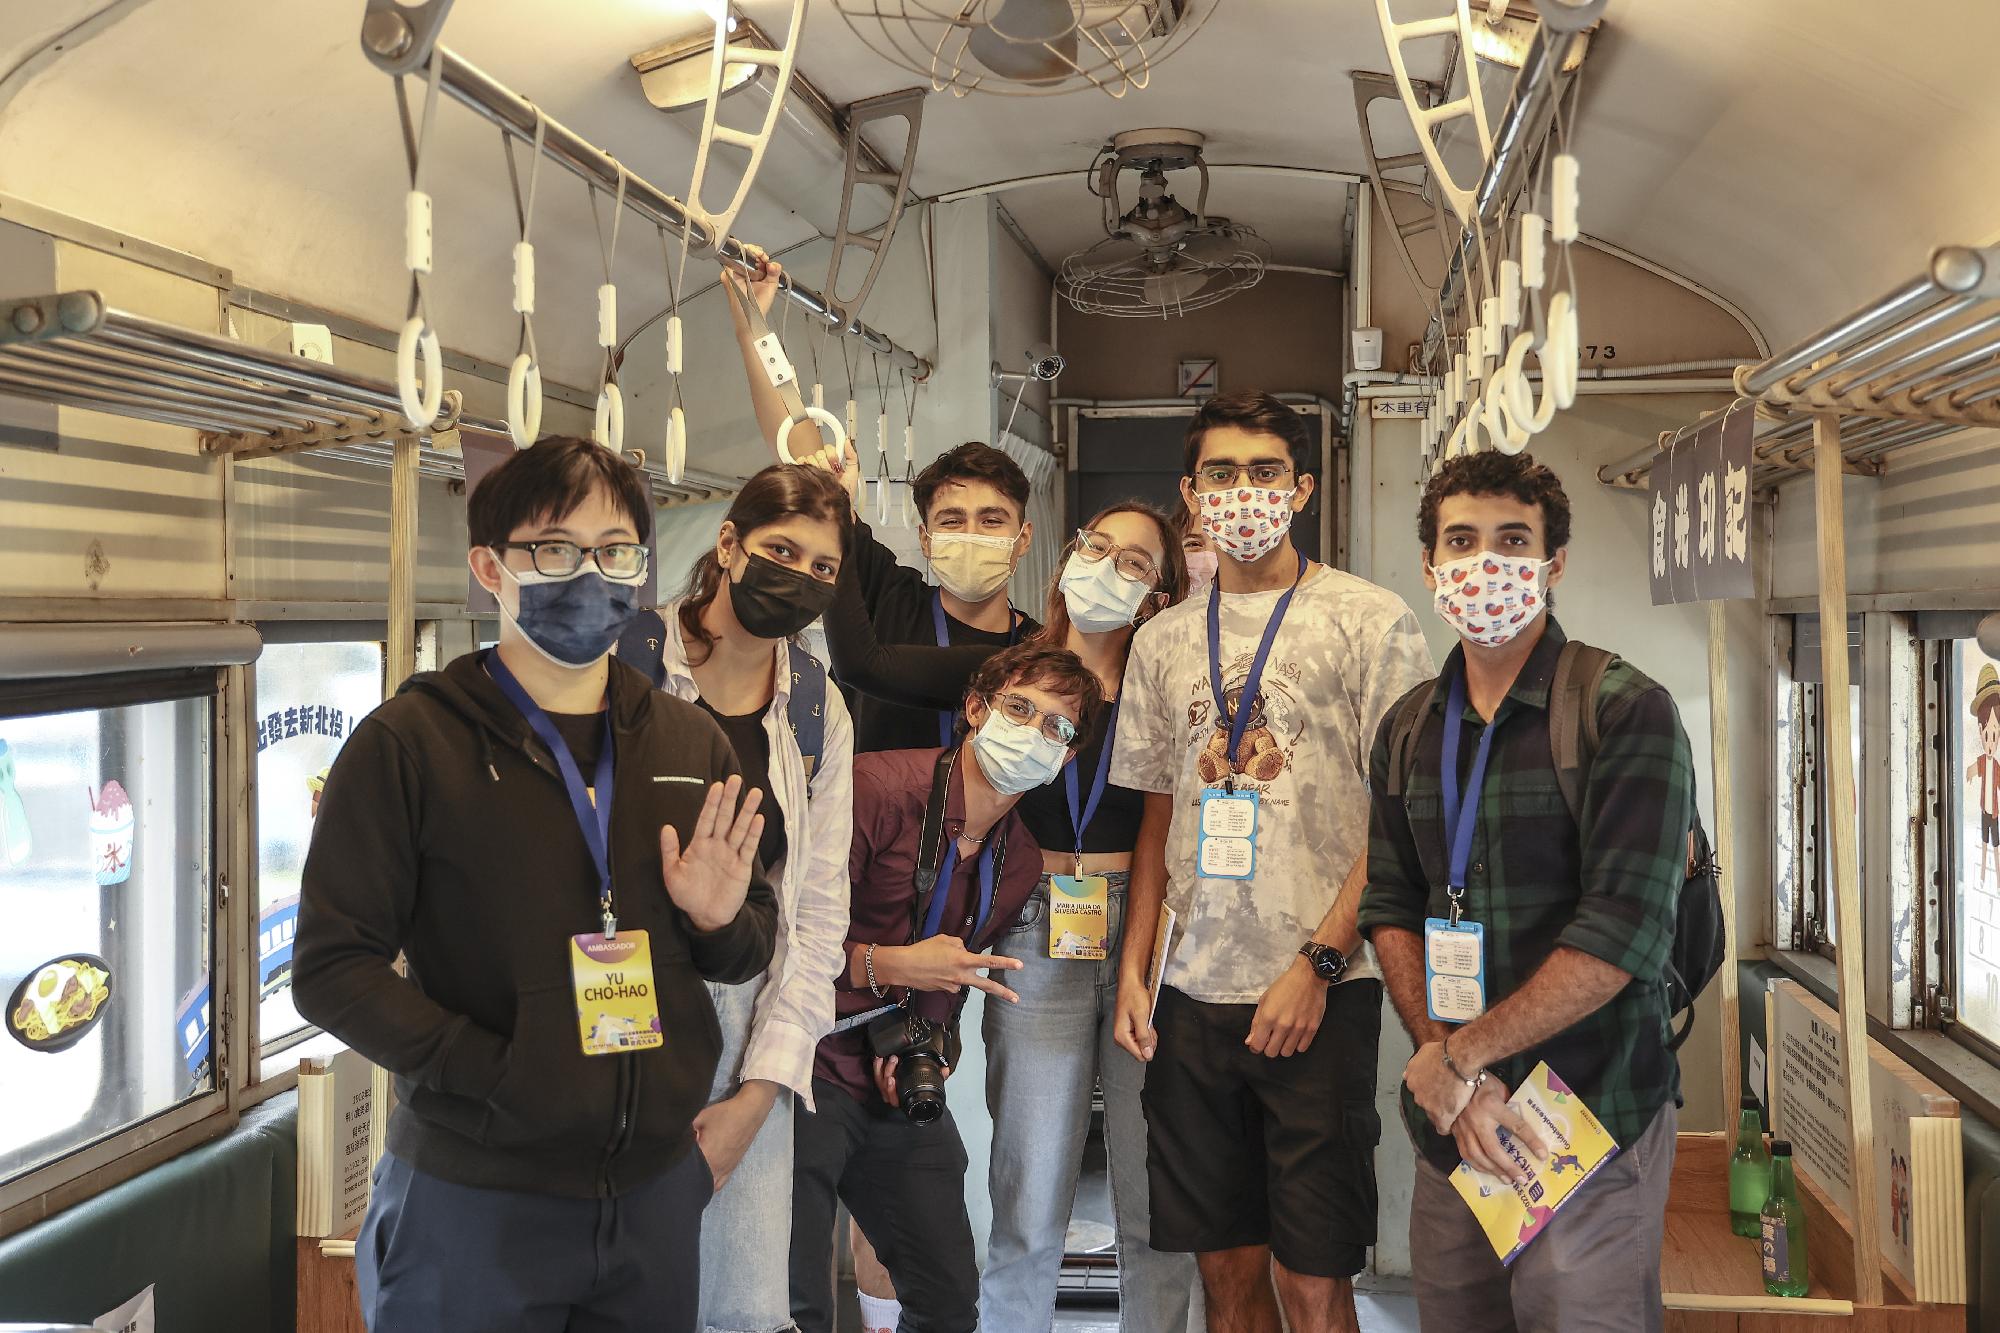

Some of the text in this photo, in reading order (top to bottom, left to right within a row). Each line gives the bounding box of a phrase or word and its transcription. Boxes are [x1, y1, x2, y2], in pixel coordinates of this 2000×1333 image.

[1269, 657, 1302, 684] NASA
[587, 942, 636, 952] AMBASSADOR
[1978, 925, 1985, 954] 8
[605, 973, 624, 985] YU
[584, 984, 648, 1002] CHO-HAO
[1541, 1116, 1571, 1151] Guidebook
